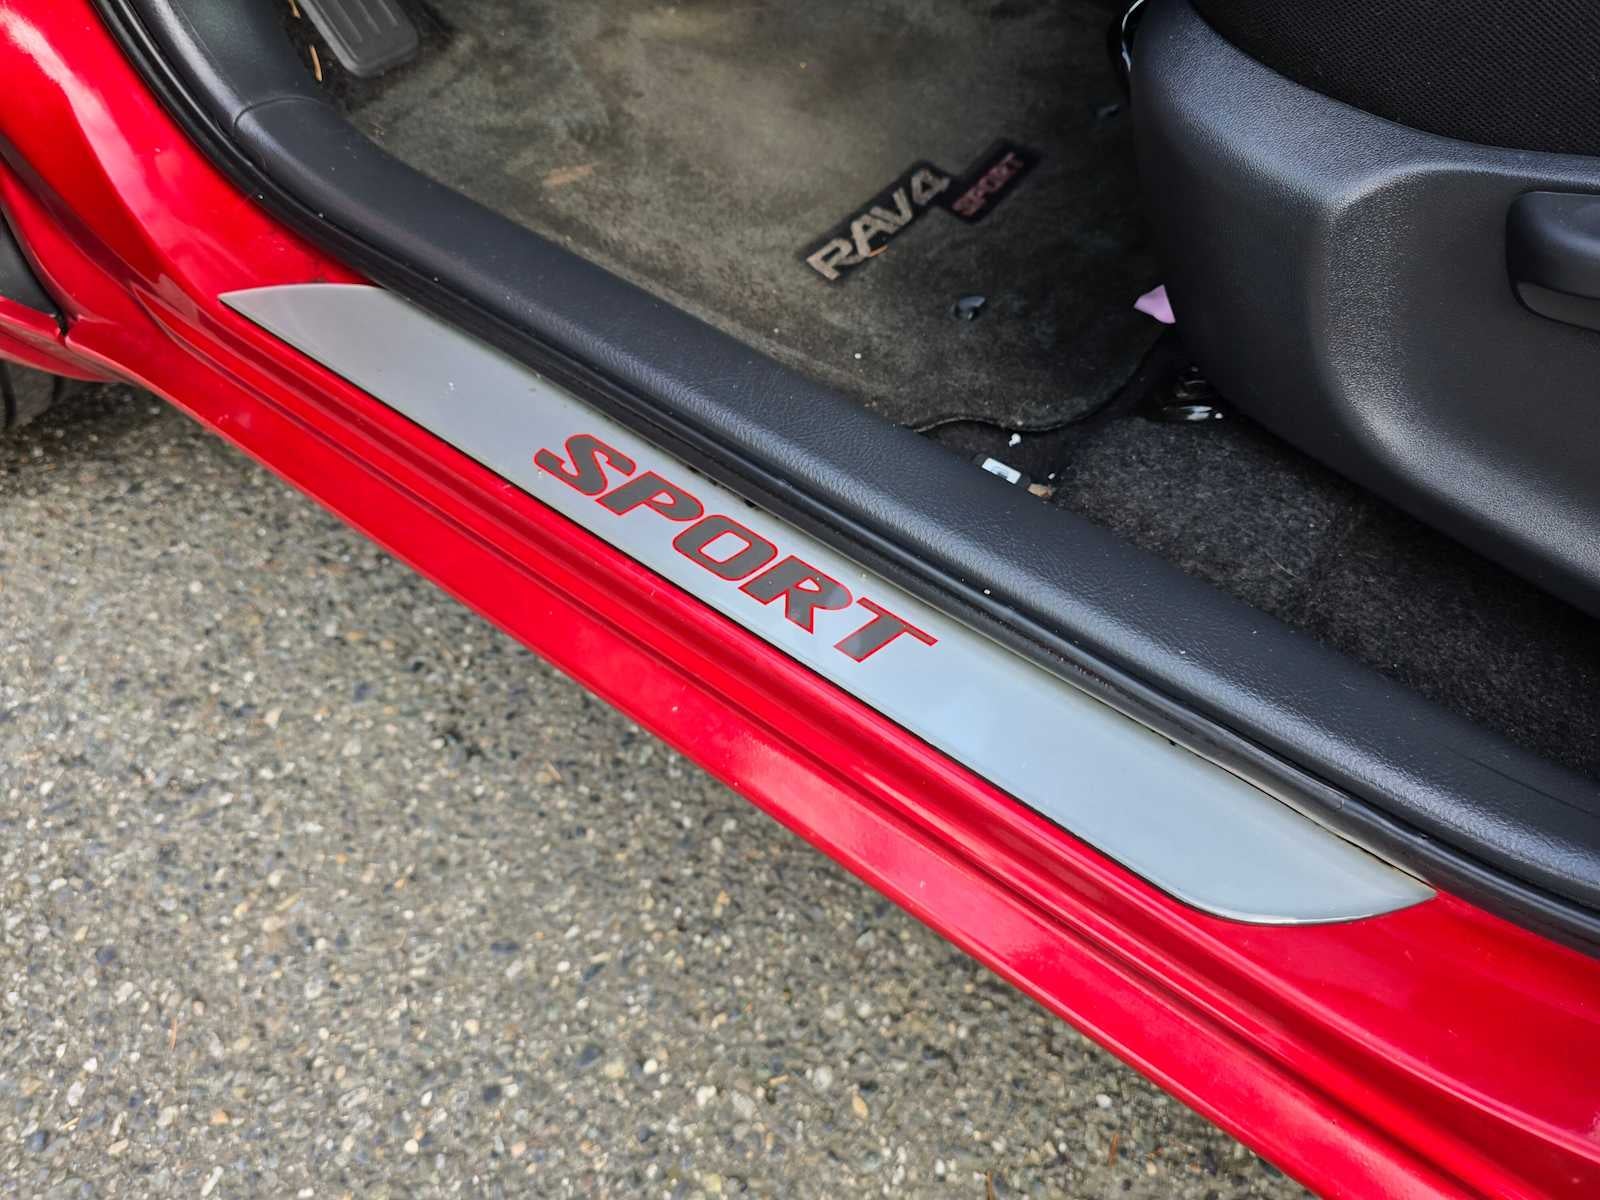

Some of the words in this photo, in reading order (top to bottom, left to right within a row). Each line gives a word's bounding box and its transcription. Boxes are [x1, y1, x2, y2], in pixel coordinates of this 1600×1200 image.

[806, 168, 950, 280] RAV4
[952, 151, 1024, 217] SPORT
[533, 433, 938, 663] SPORT
